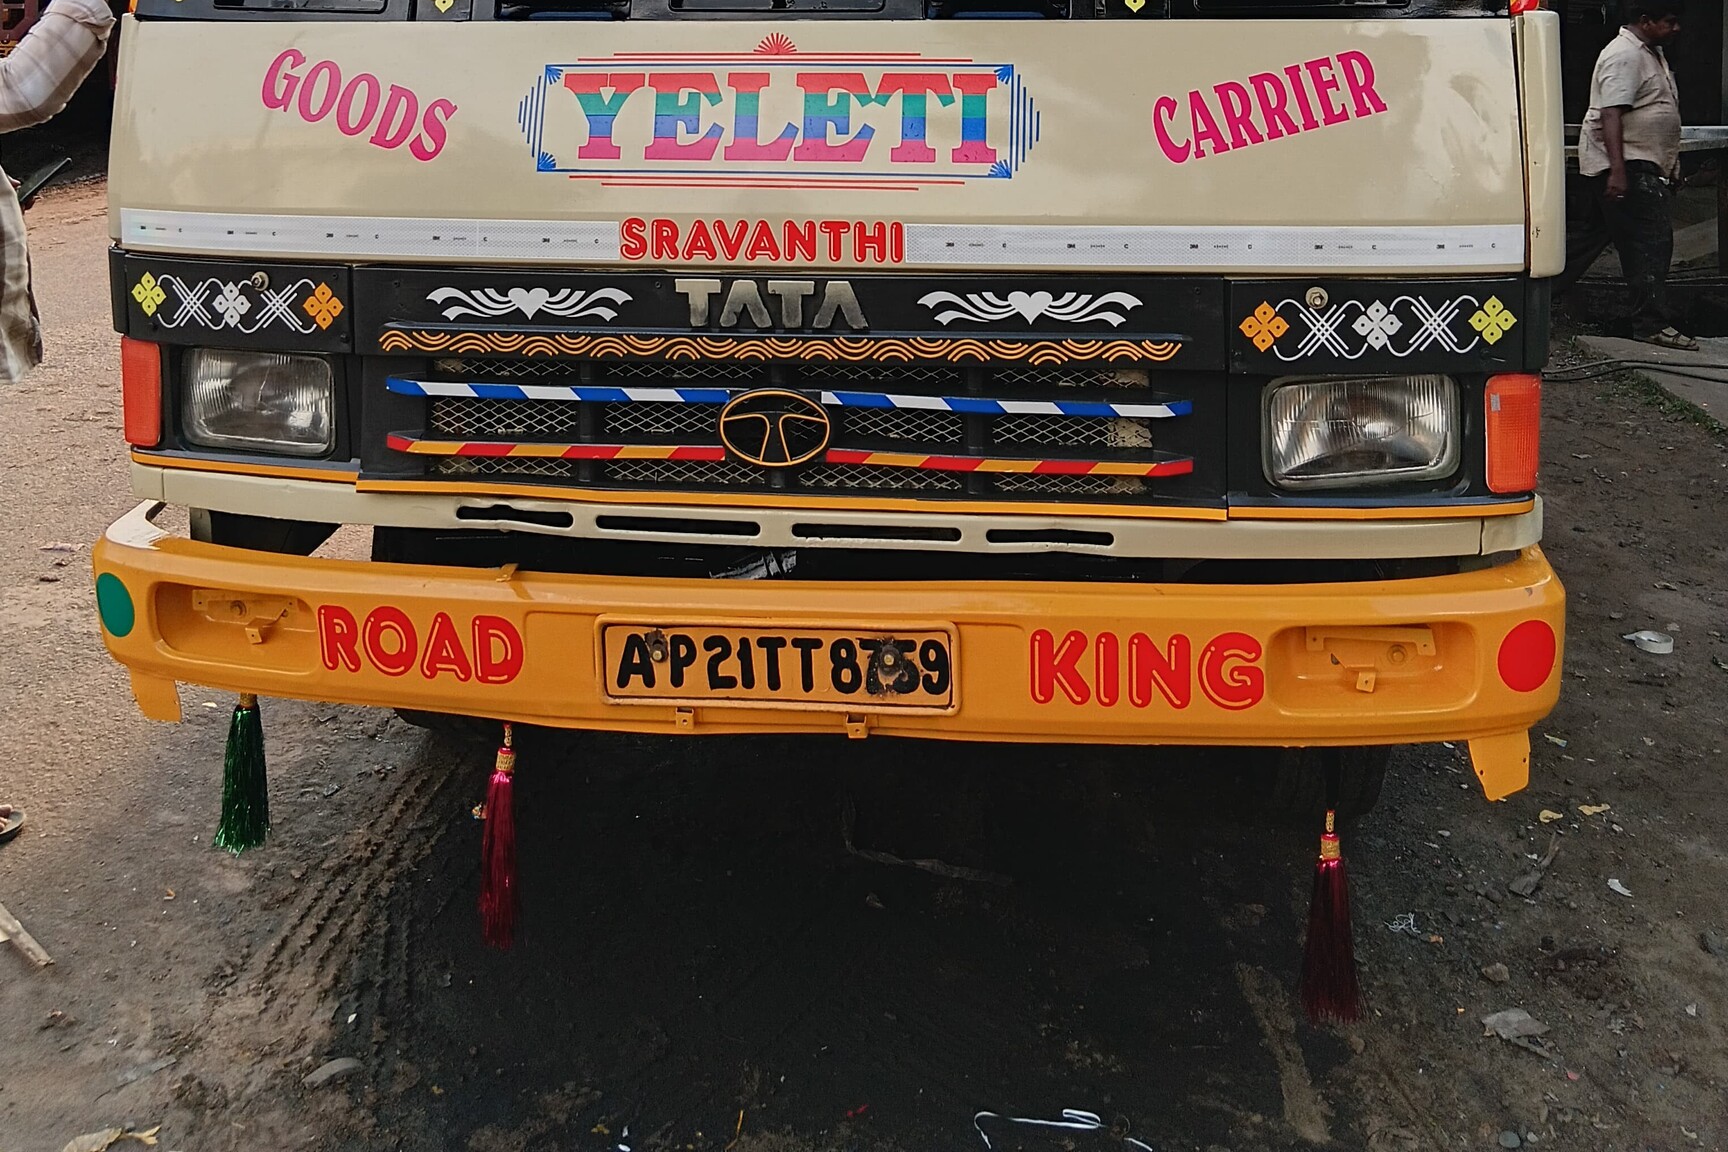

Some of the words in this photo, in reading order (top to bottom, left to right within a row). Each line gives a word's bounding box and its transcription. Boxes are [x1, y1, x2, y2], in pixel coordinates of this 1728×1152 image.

[261, 48, 458, 162] GOODS
[564, 72, 998, 164] YELETI
[1153, 50, 1388, 165] CARRIER
[620, 217, 905, 264] SRAVANTHI
[675, 278, 870, 330] TATA
[317, 604, 525, 685] ROAD
[1029, 628, 1266, 711] KING
